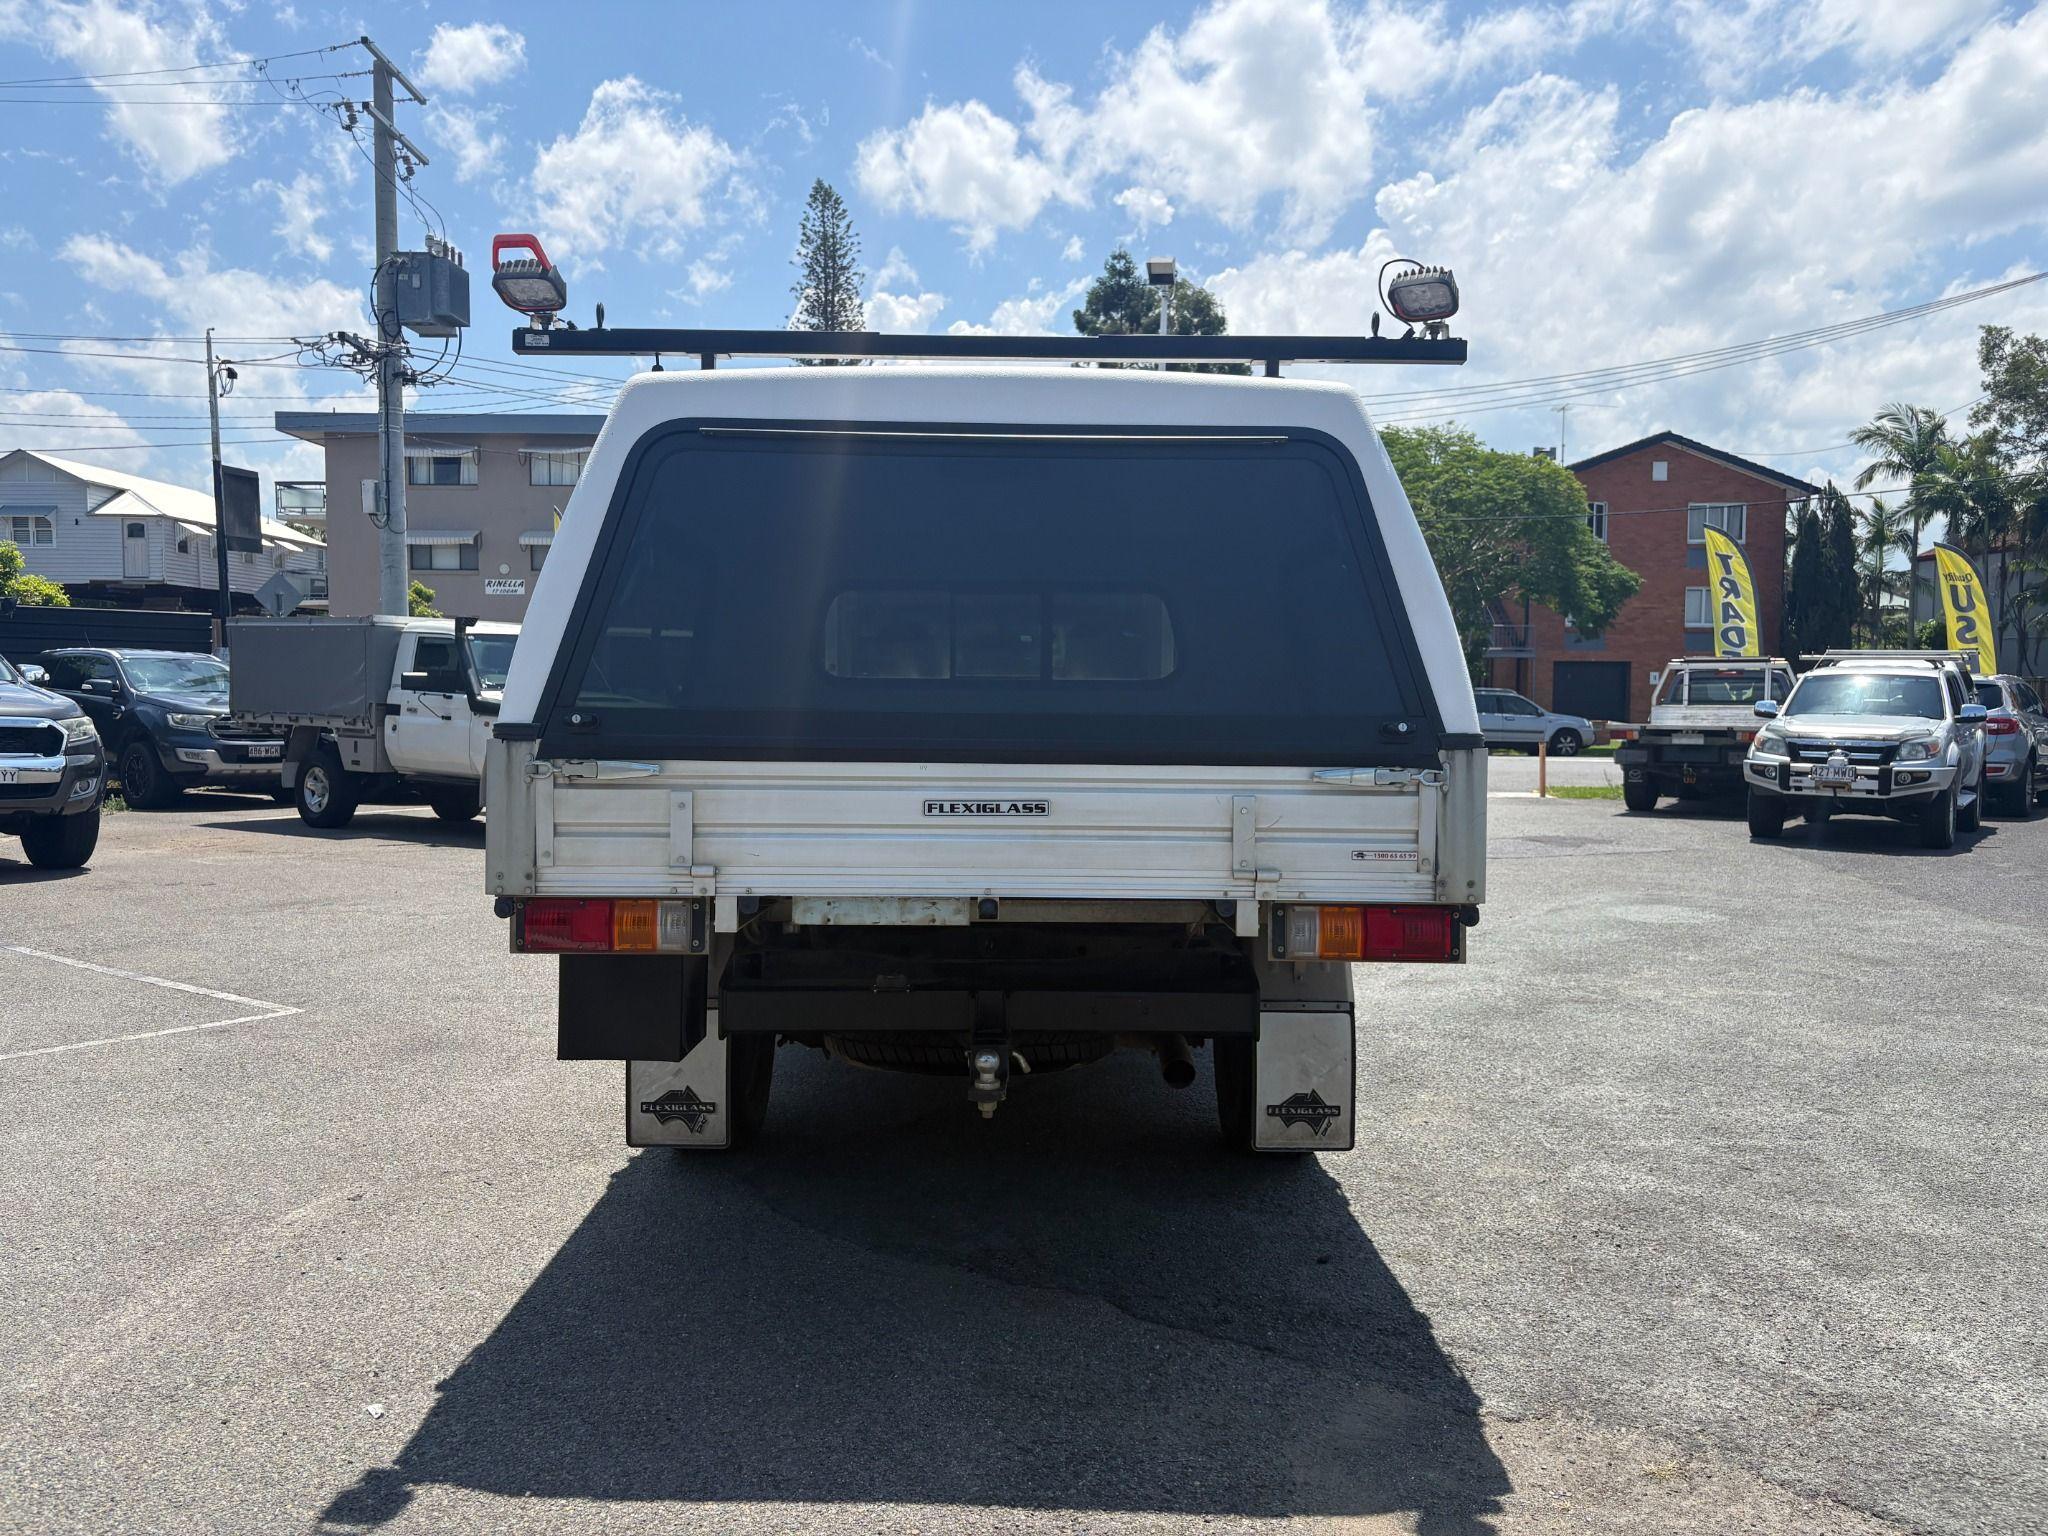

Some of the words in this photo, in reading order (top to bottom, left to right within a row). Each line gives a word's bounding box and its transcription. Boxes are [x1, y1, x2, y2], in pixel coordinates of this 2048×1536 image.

[486, 580, 524, 588] RINELLA
[927, 803, 1047, 814] FLEXIGLASS
[642, 1103, 715, 1112] FLEXIGLASS
[1268, 1107, 1340, 1115] FLEXIGLASS
